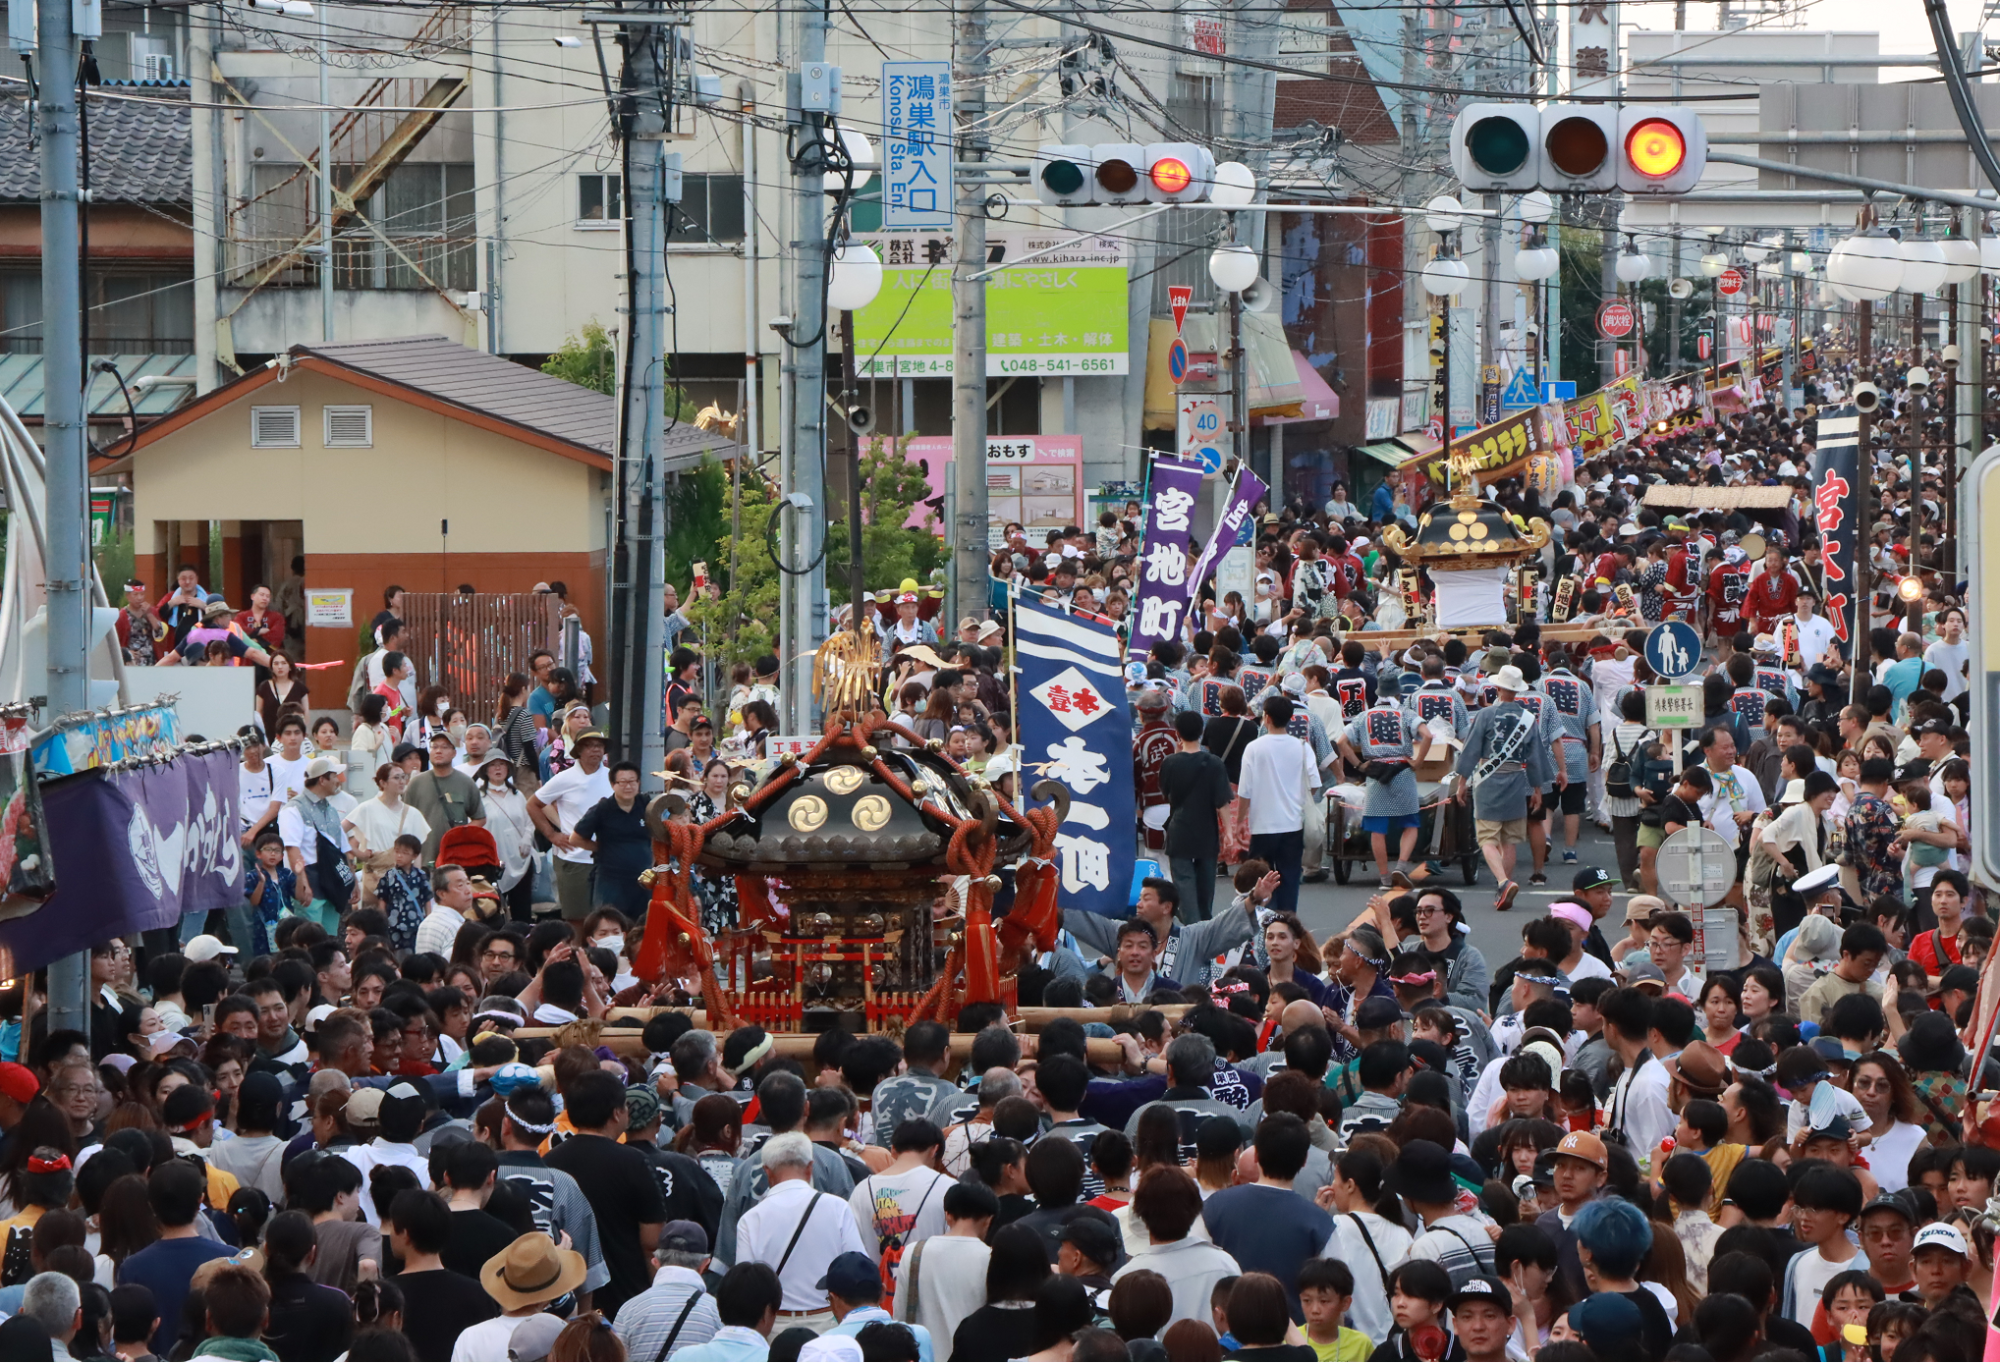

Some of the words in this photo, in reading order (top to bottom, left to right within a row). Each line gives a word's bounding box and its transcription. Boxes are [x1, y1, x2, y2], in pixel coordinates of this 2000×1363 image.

[938, 73, 950, 110] 鴻巣市
[889, 75, 905, 136] Konosu
[906, 75, 938, 212] 鴻巣駅入口
[890, 143, 906, 175] Sta.
[891, 182, 906, 214] Ent.
[889, 239, 914, 250] 株式
[889, 251, 915, 263] 会社
[1604, 314, 1630, 327] 消火栓
[1009, 359, 1115, 372] 048-541-6561
[1196, 413, 1217, 430] 40
[987, 444, 1030, 458] おもす
[1139, 486, 1195, 641] 宮地町
[1555, 581, 1573, 616] 宮地町
[1150, 743, 1168, 763] 武
[1564, 1135, 1578, 1148] NY
